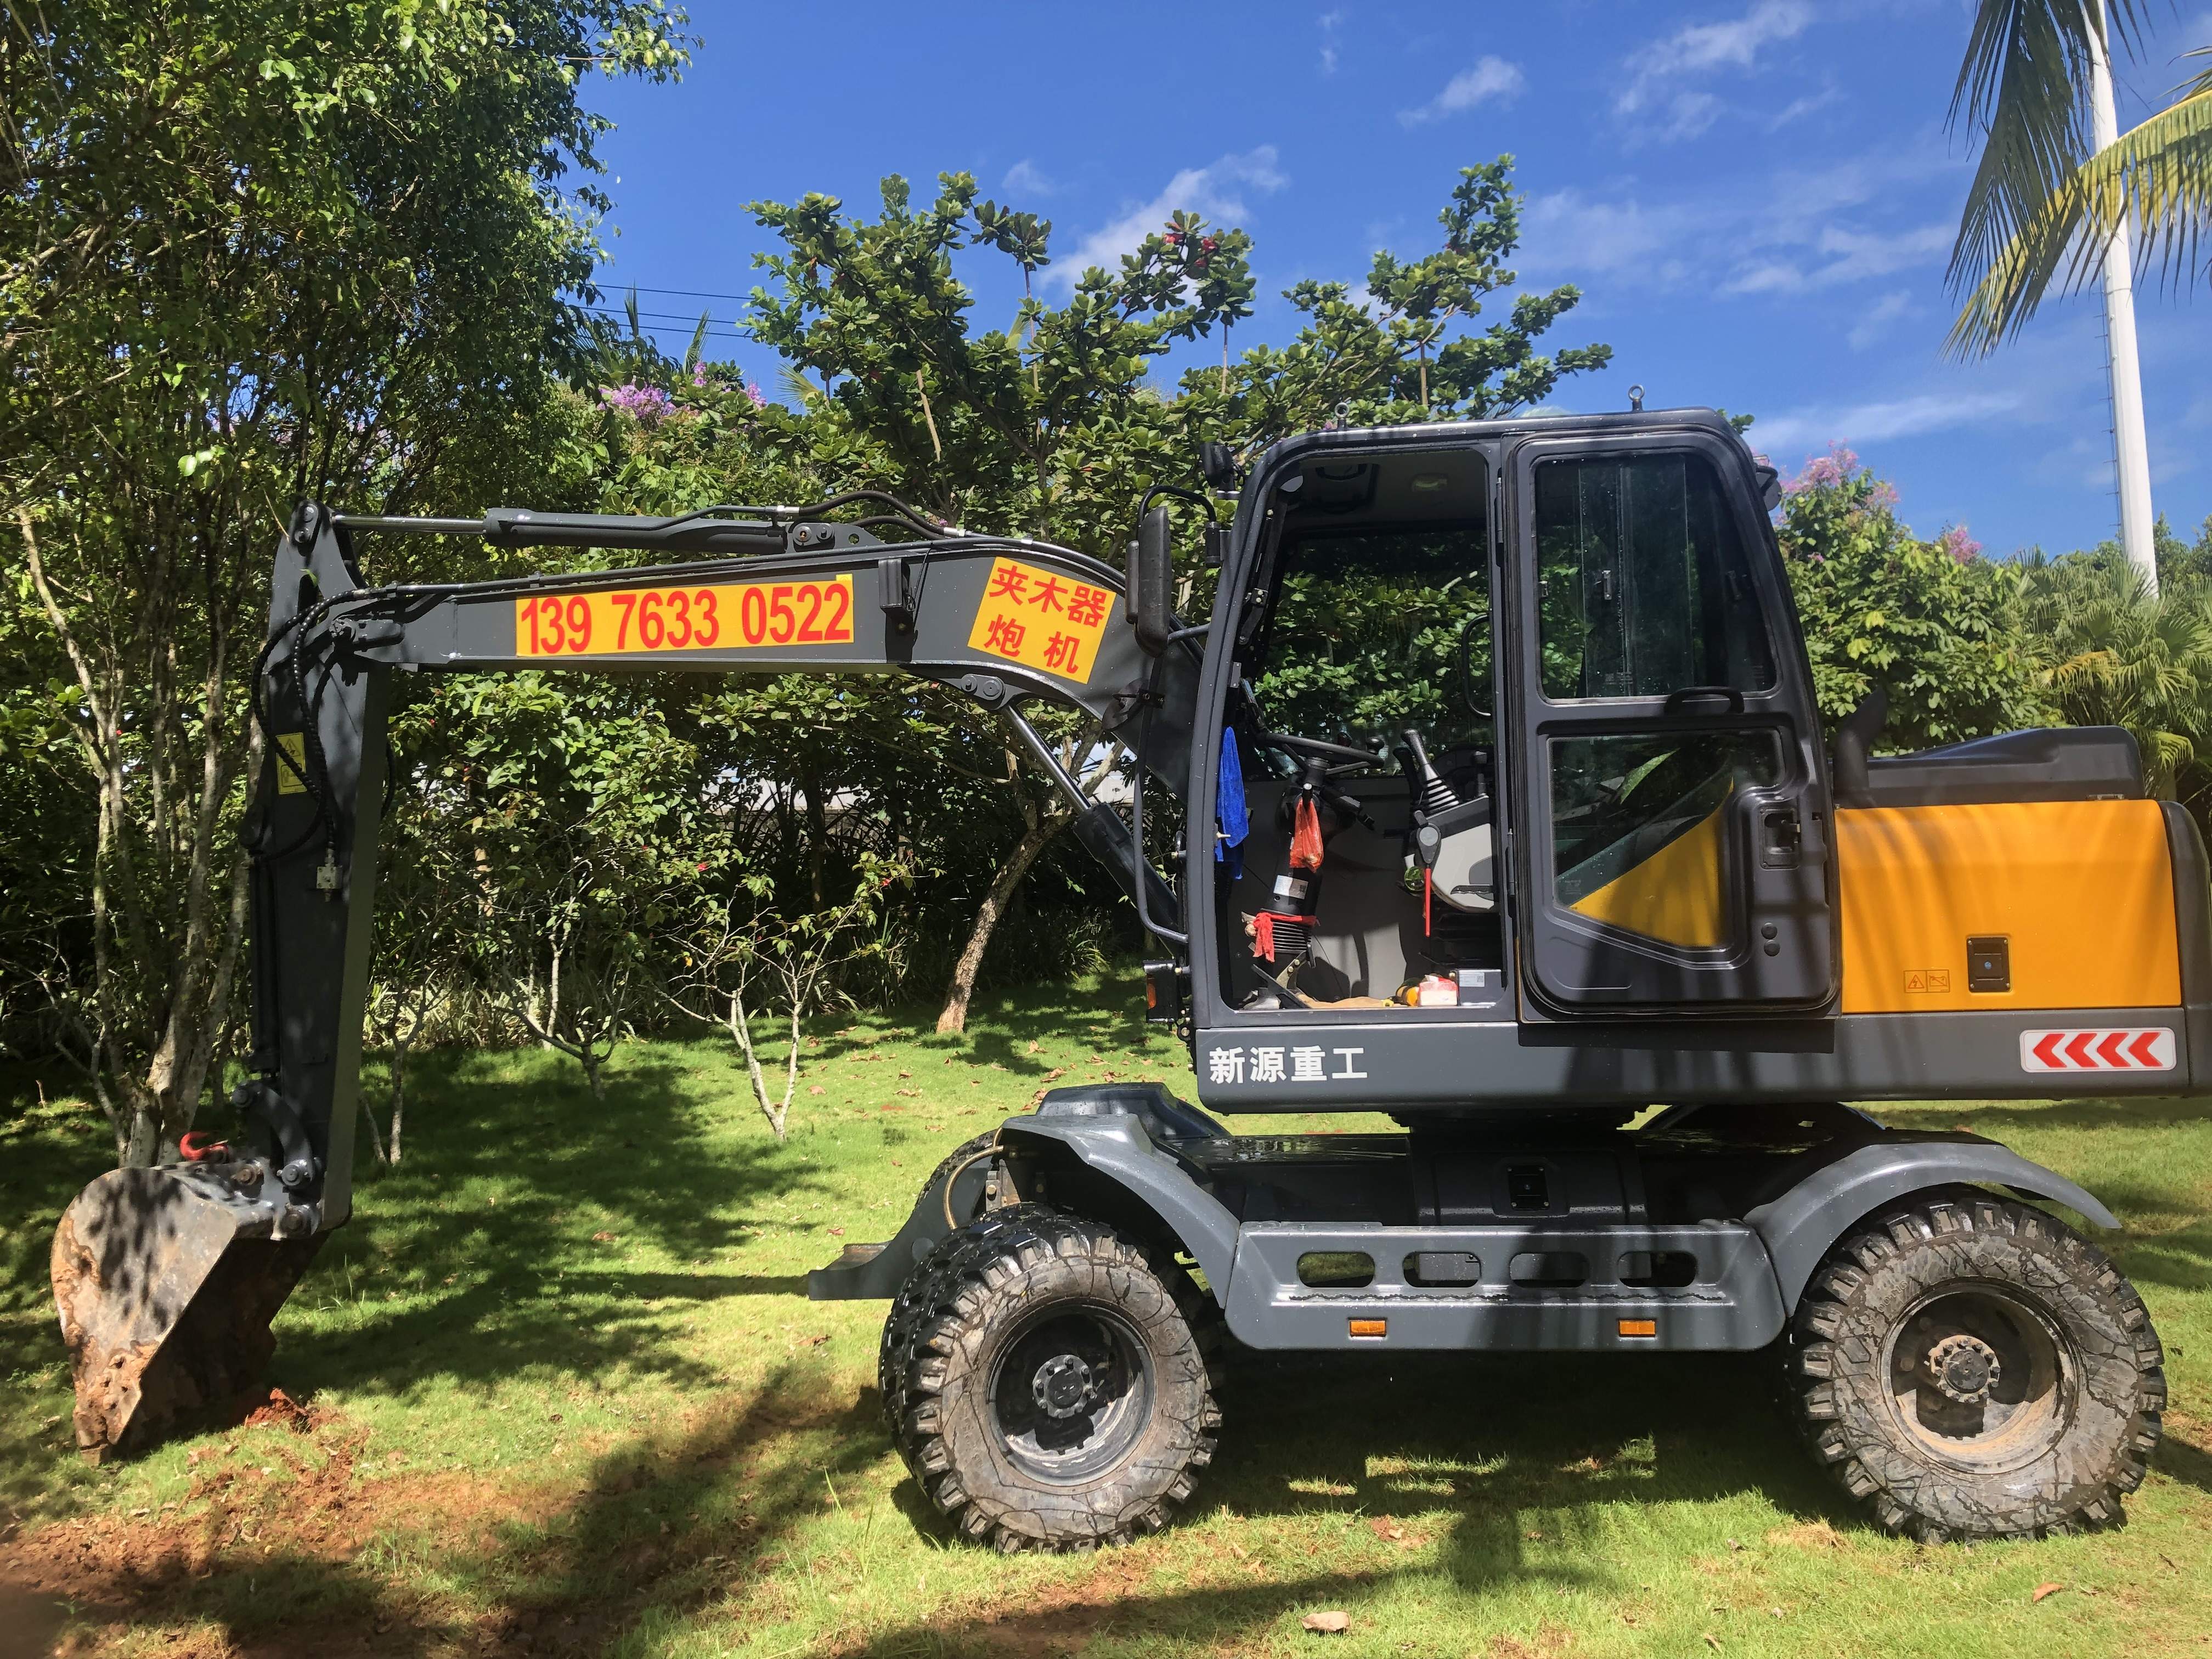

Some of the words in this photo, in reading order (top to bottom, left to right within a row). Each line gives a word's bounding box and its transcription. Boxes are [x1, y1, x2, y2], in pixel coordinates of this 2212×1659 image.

[521, 596, 592, 654] 139
[612, 589, 719, 650] 7633
[742, 584, 850, 645] 0522
[989, 566, 1107, 628] 夹木器
[1209, 1045, 1368, 1084] 新源重工
